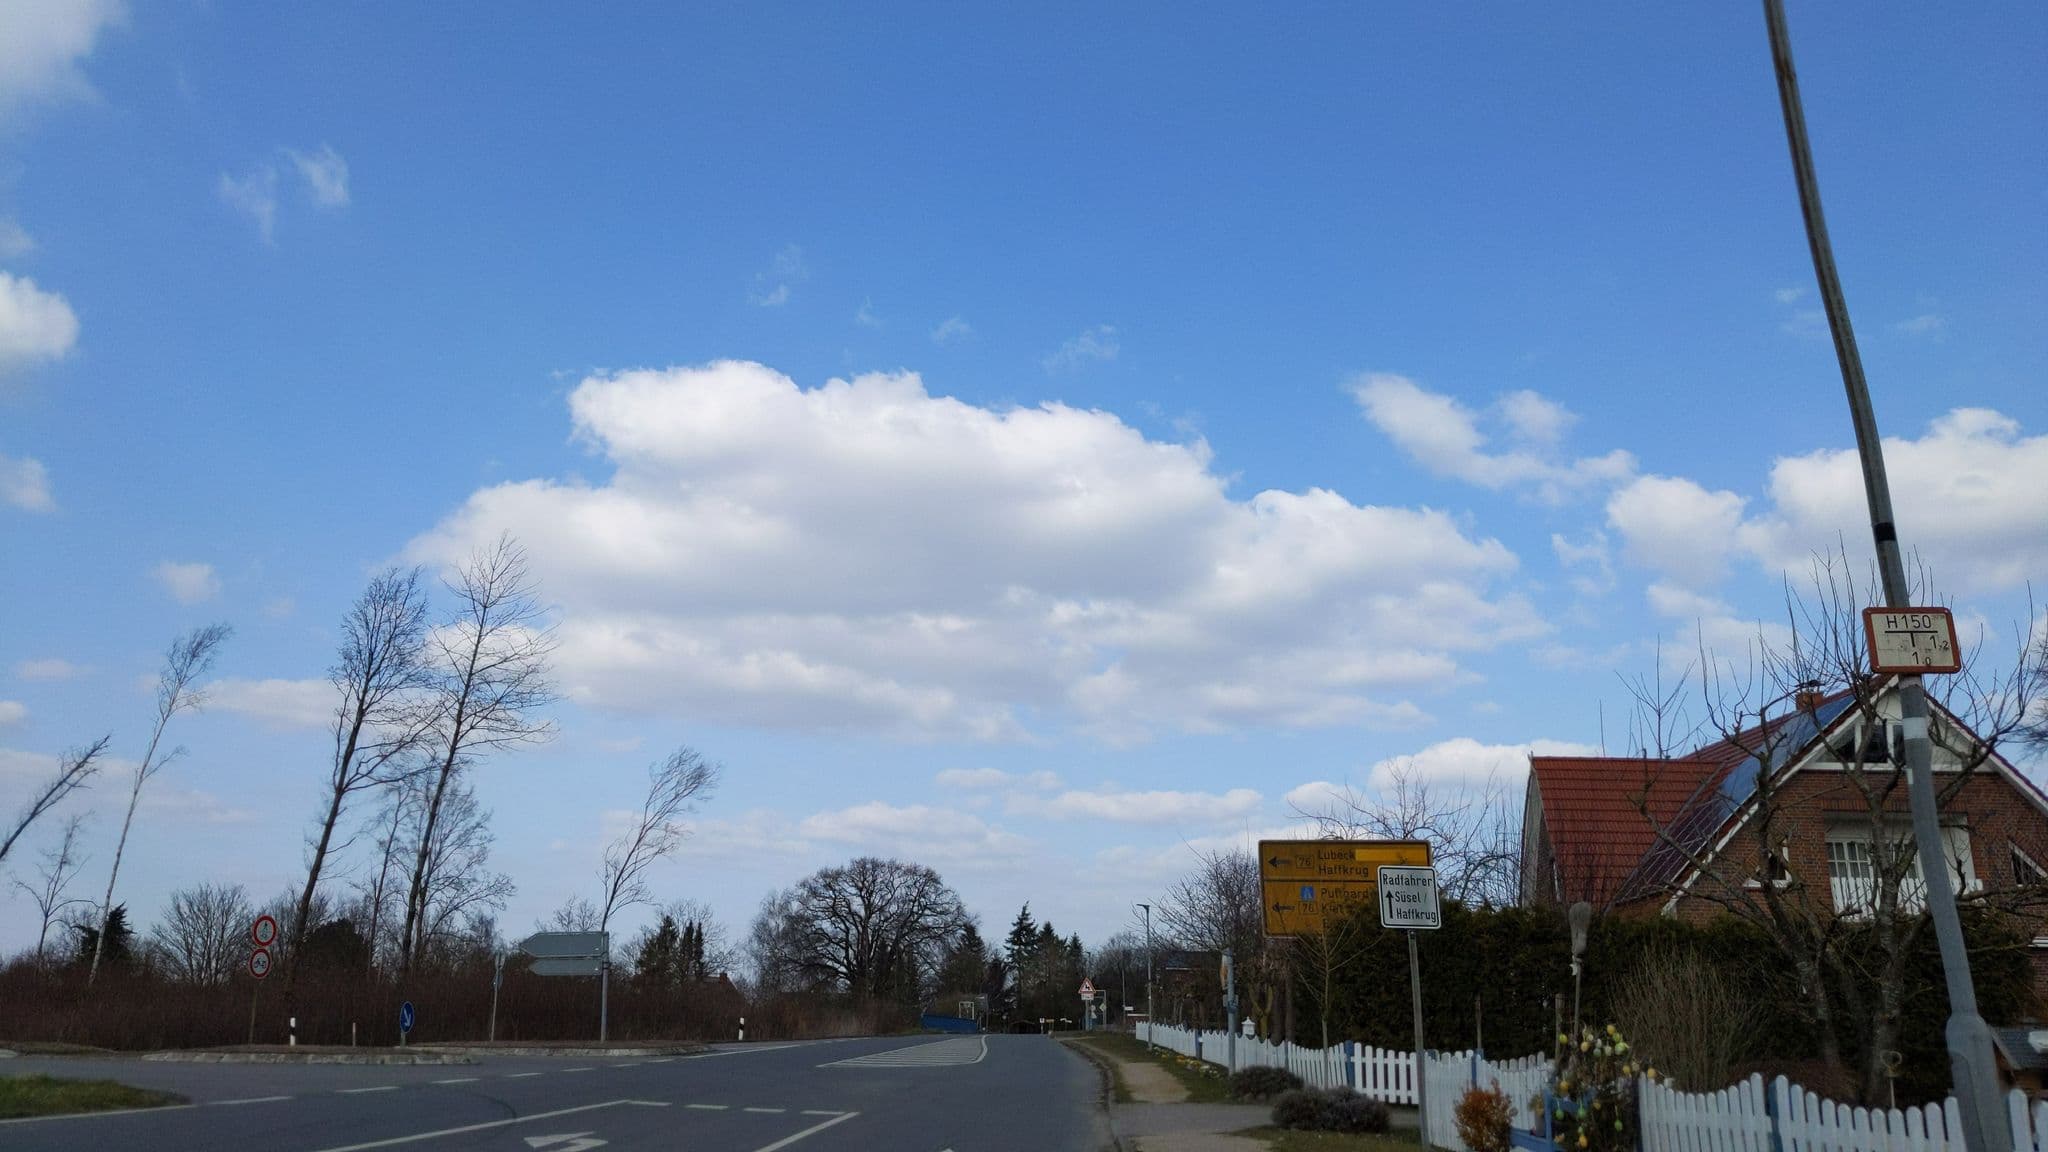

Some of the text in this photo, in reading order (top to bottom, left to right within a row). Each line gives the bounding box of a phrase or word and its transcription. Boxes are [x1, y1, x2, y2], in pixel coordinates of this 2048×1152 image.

[1318, 865, 1369, 877] Haffkrug
[1382, 873, 1433, 886] Radfahrer
[1394, 890, 1421, 903] Süsel
[1396, 908, 1437, 923] Haffkrug
